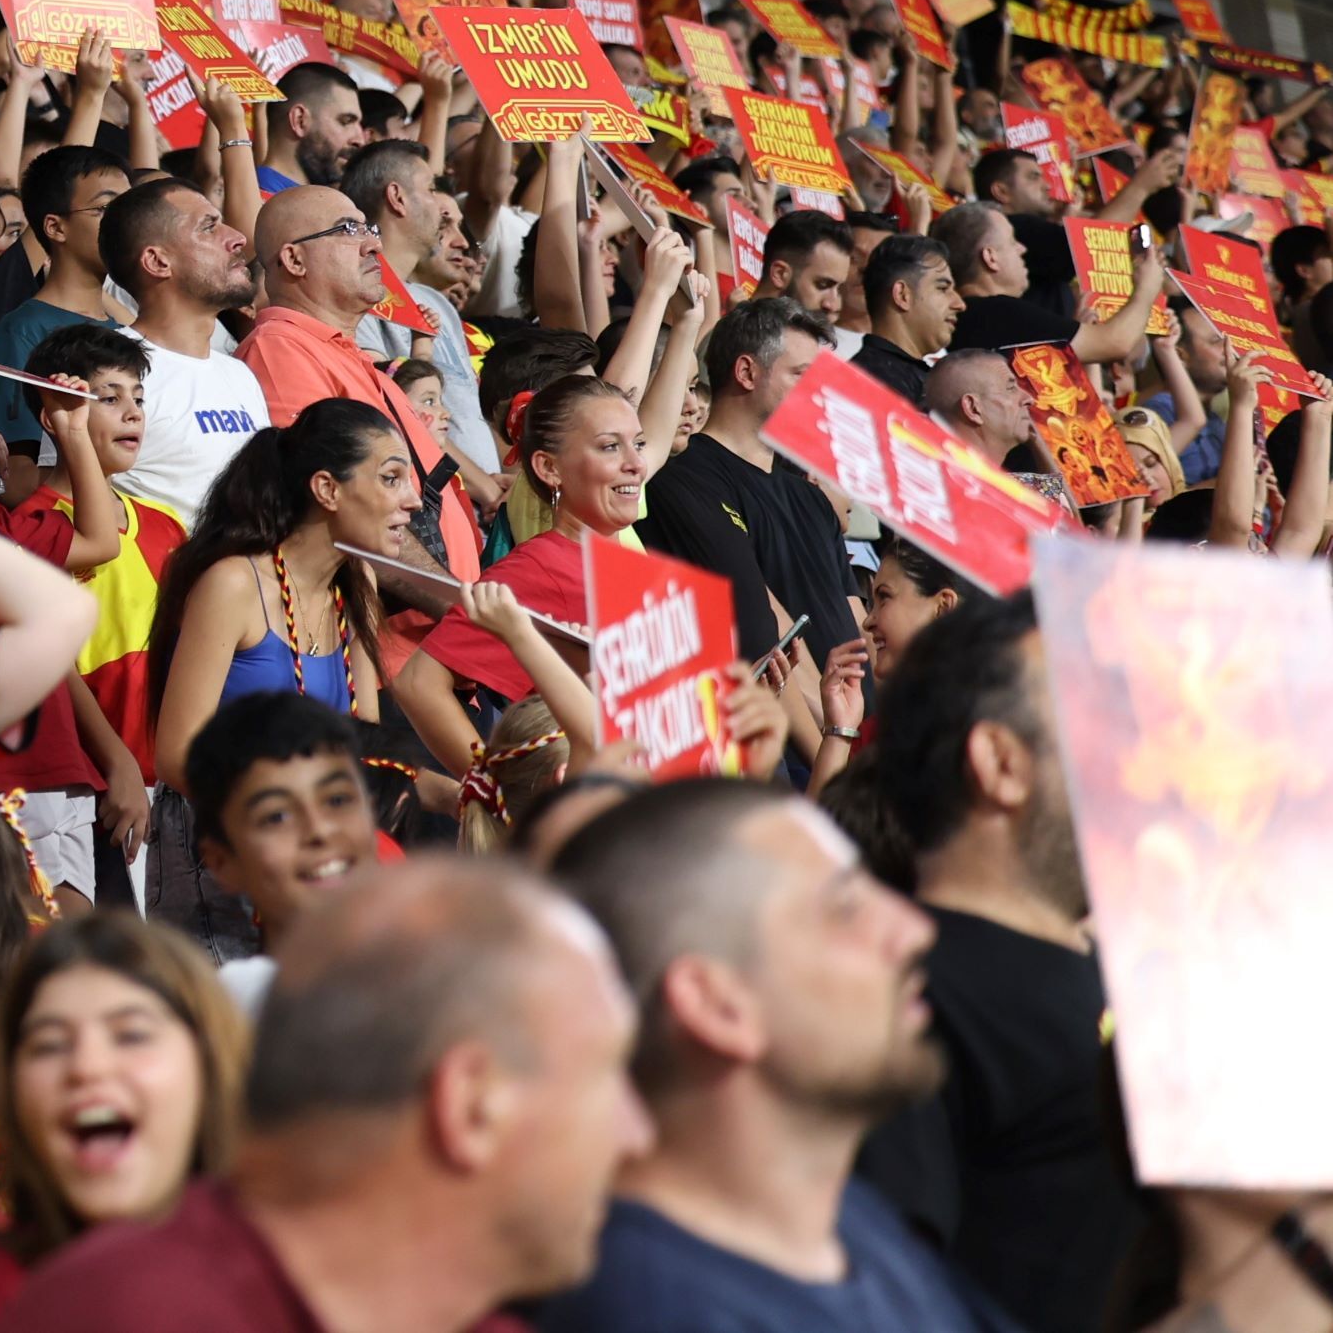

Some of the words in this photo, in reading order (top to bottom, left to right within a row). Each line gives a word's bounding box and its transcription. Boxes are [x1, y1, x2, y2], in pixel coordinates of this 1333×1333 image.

[47, 8, 128, 36] GÖZTEPE
[463, 16, 580, 55] İZMİR'İN
[179, 35, 232, 59] UMUDU
[495, 59, 588, 90] UMUDU
[751, 118, 817, 145] TAKIMINI
[749, 132, 834, 166] TUTUYORUM
[194, 404, 255, 435] mavi
